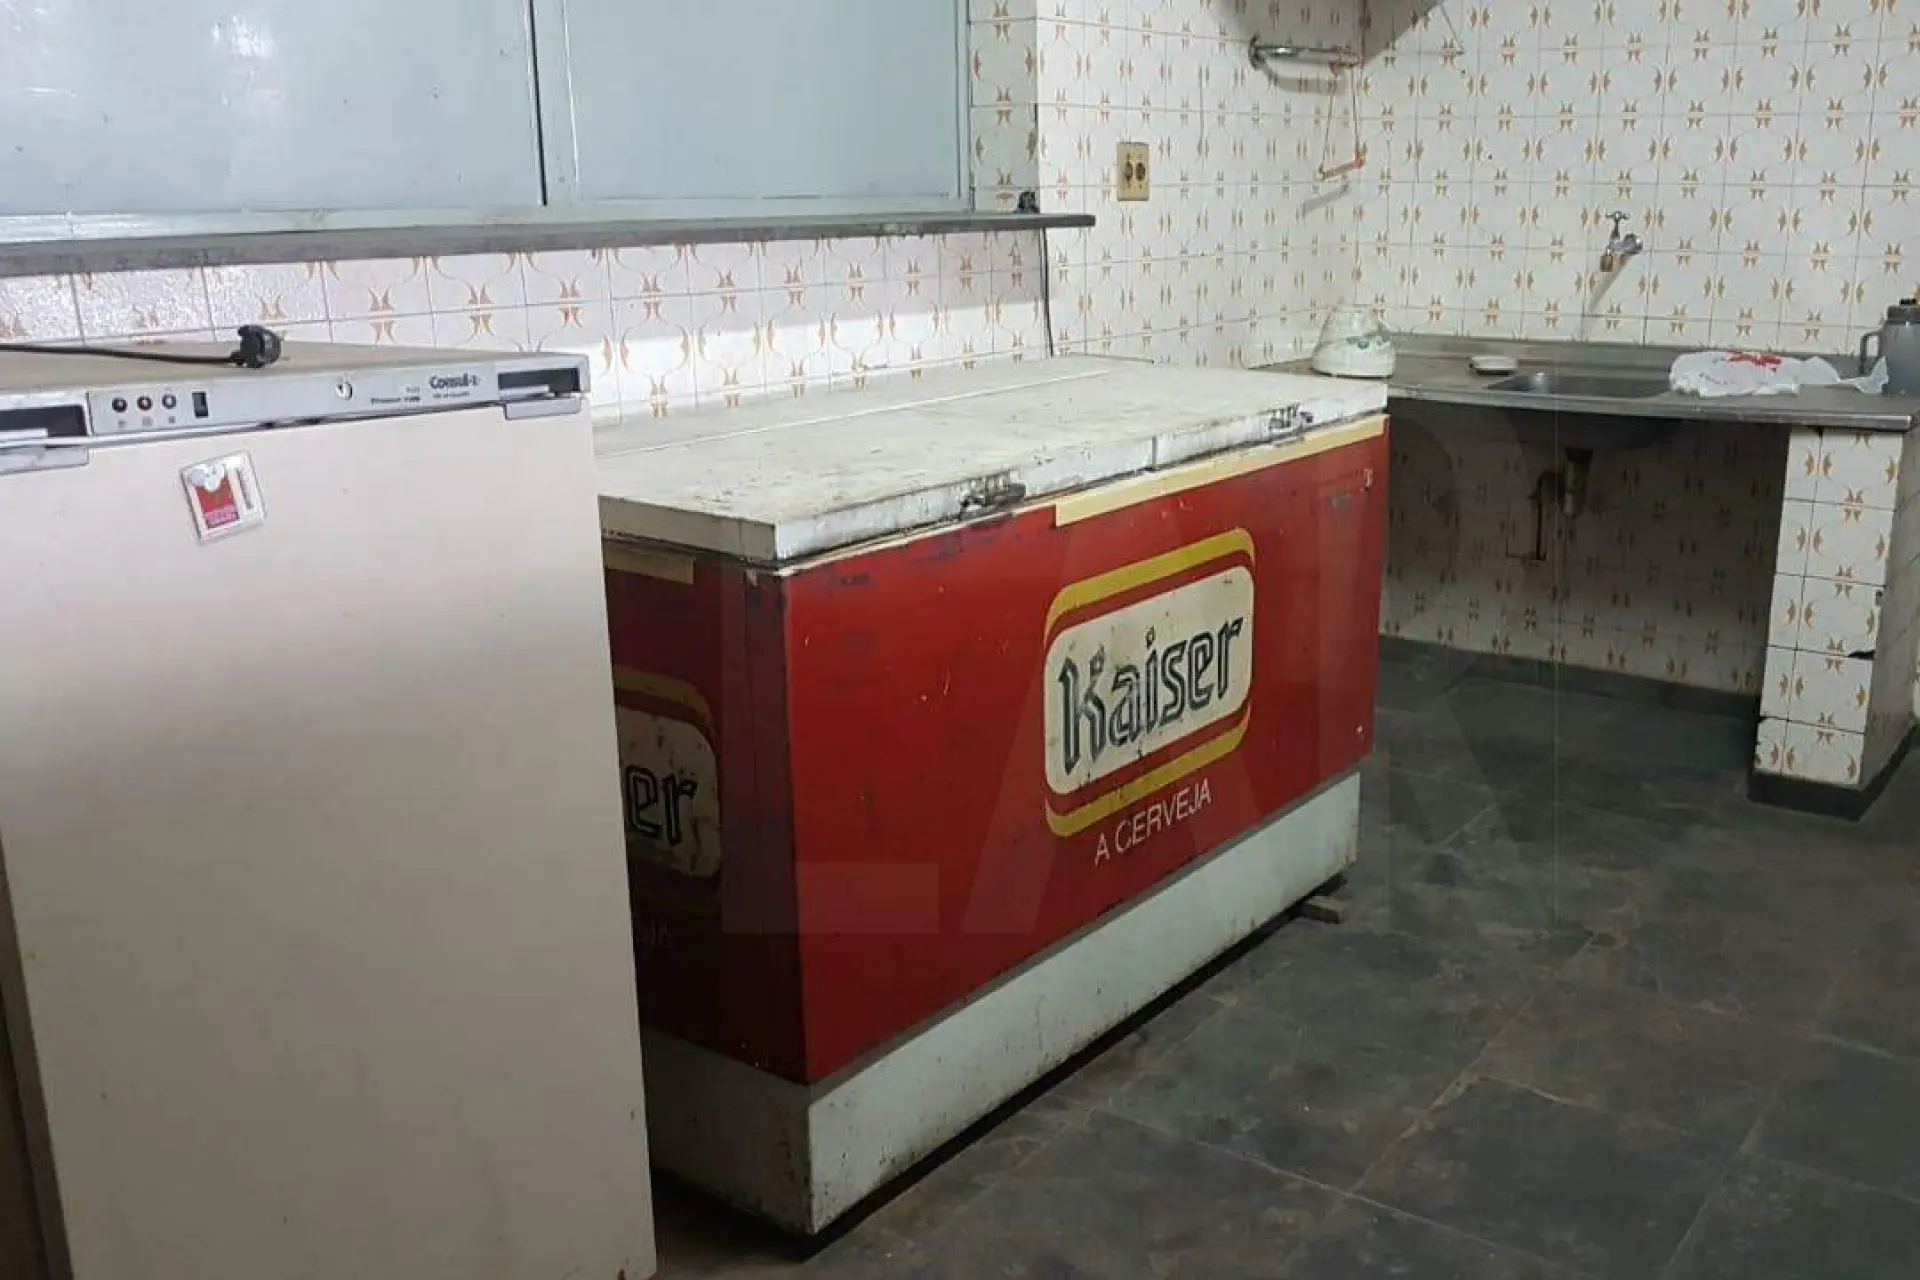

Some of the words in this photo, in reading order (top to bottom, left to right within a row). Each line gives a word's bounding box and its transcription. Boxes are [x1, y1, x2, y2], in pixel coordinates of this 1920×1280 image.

[1058, 616, 1244, 776] Kaiser
[1094, 832, 1112, 866] A
[1114, 778, 1212, 854] CERVEJA
